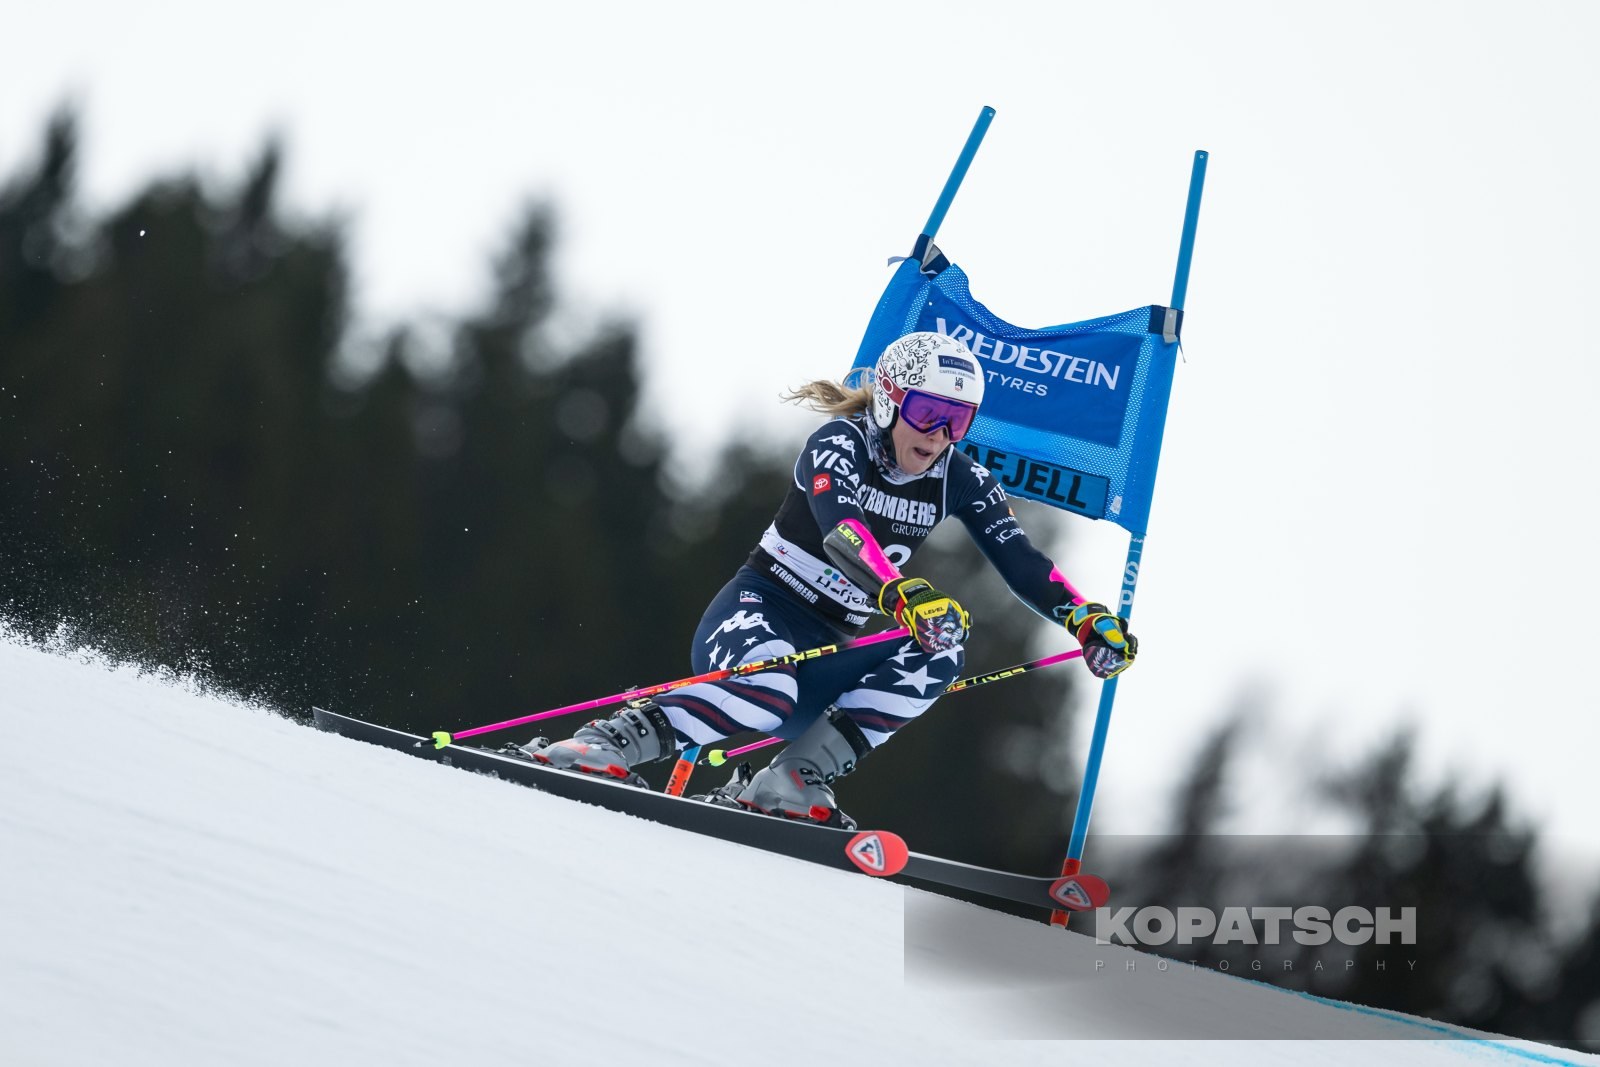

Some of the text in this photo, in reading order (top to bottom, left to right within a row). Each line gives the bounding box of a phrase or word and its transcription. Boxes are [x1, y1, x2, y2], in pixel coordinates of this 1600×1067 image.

[987, 370, 1049, 397] TYRES
[810, 449, 860, 489] VISA
[956, 443, 1087, 510] AFJELL
[837, 523, 862, 546] LEKI
[923, 606, 945, 616] LEVEL
[784, 645, 838, 665] LEKI
